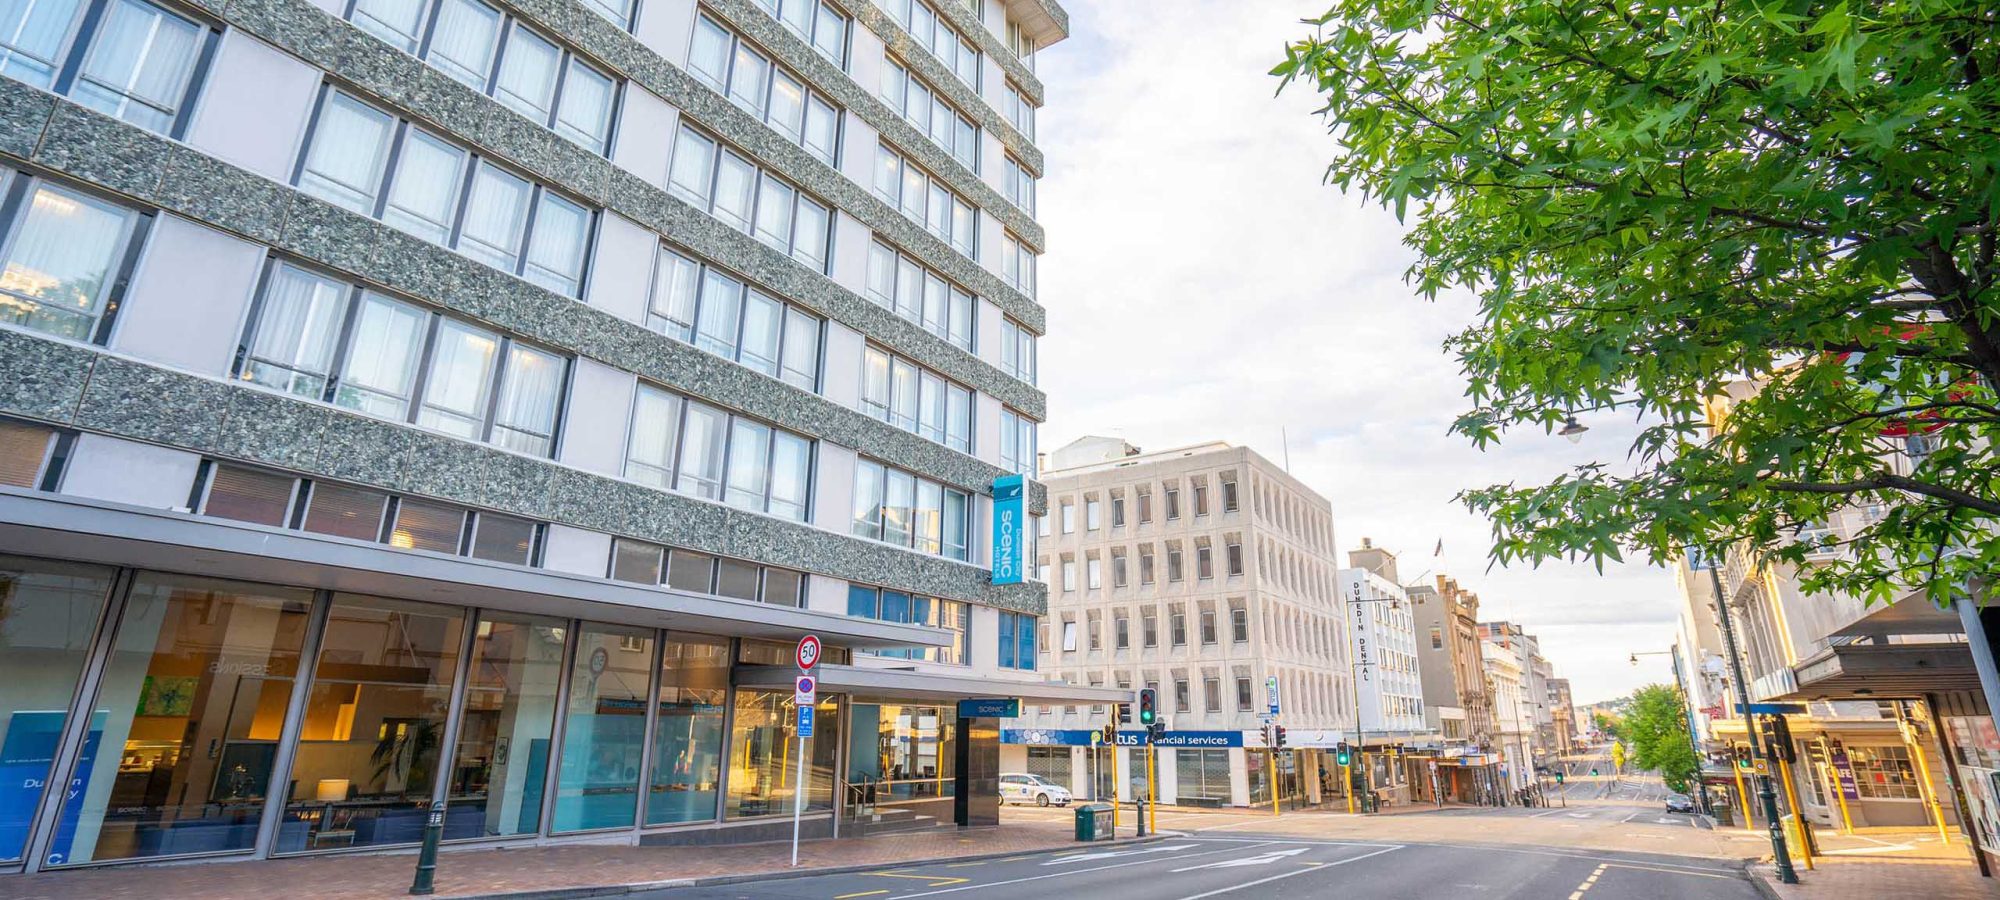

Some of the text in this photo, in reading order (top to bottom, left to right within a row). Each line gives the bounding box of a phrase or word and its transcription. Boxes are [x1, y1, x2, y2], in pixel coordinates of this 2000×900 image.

[1353, 582, 1369, 681] DUNEDIN DENTAL
[802, 645, 815, 659] 50
[1187, 736, 1229, 745] services
